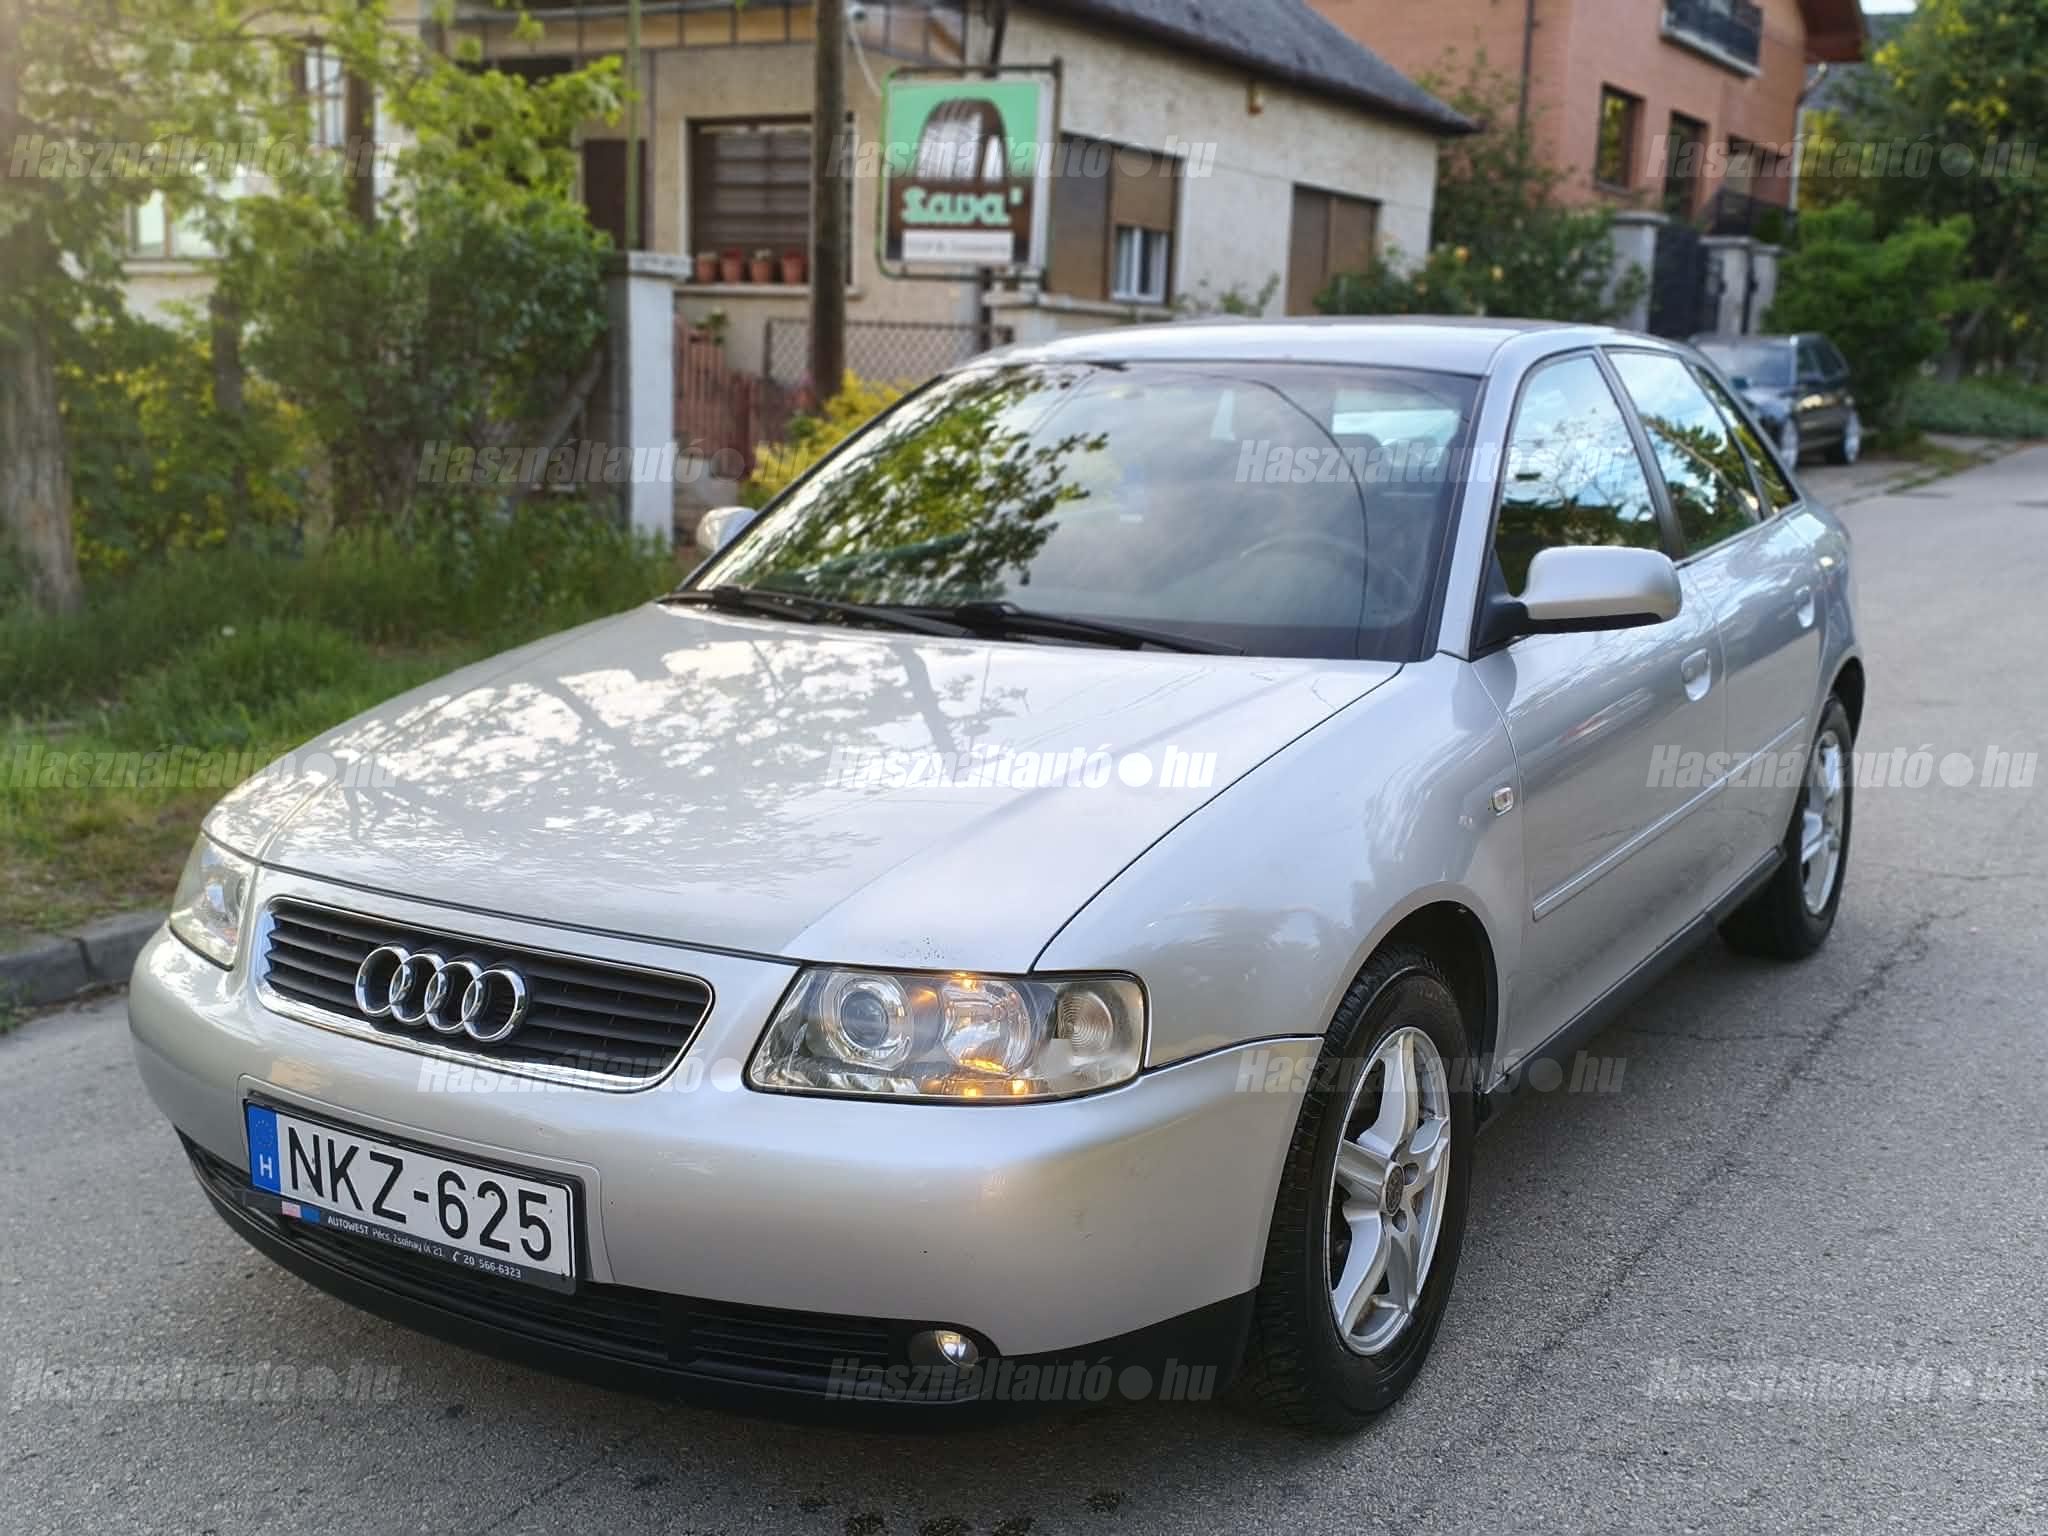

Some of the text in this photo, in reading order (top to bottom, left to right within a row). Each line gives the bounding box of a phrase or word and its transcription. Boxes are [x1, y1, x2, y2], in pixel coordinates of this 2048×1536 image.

[259, 1153, 274, 1180] H
[288, 1126, 552, 1261] NKZ-625
[327, 1215, 369, 1236] AUTOWEST
[479, 1257, 522, 1280] 566-6323
